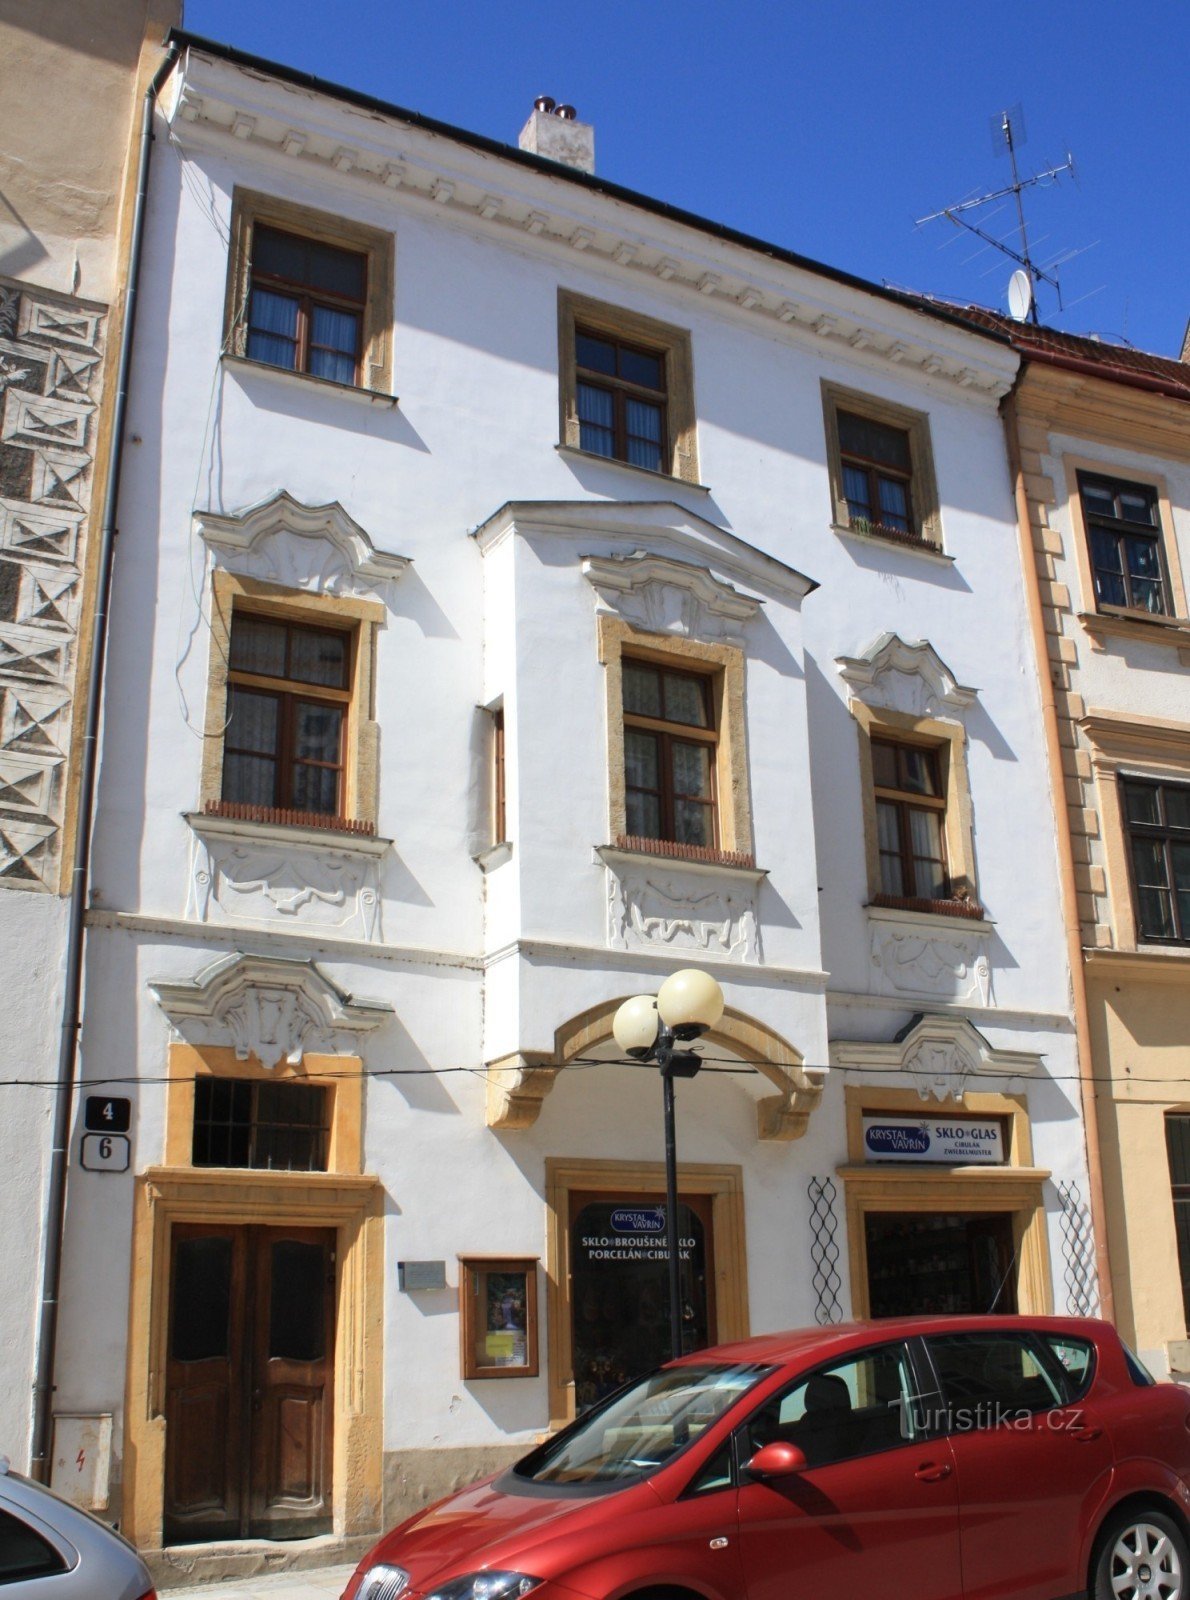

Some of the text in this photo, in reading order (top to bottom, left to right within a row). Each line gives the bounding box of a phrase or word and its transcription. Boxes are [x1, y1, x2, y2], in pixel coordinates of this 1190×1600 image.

[102, 1102, 114, 1120] 4
[869, 1129, 908, 1140] KRYSTAL
[935, 1127, 997, 1140] SKLO GLAS
[99, 1137, 112, 1159] 6
[614, 1213, 647, 1222] KRYSTAL
[582, 1237, 609, 1247] SKLO
[615, 1235, 668, 1247] BROUŠENÉ
[588, 1247, 642, 1259] PORCELÁN
